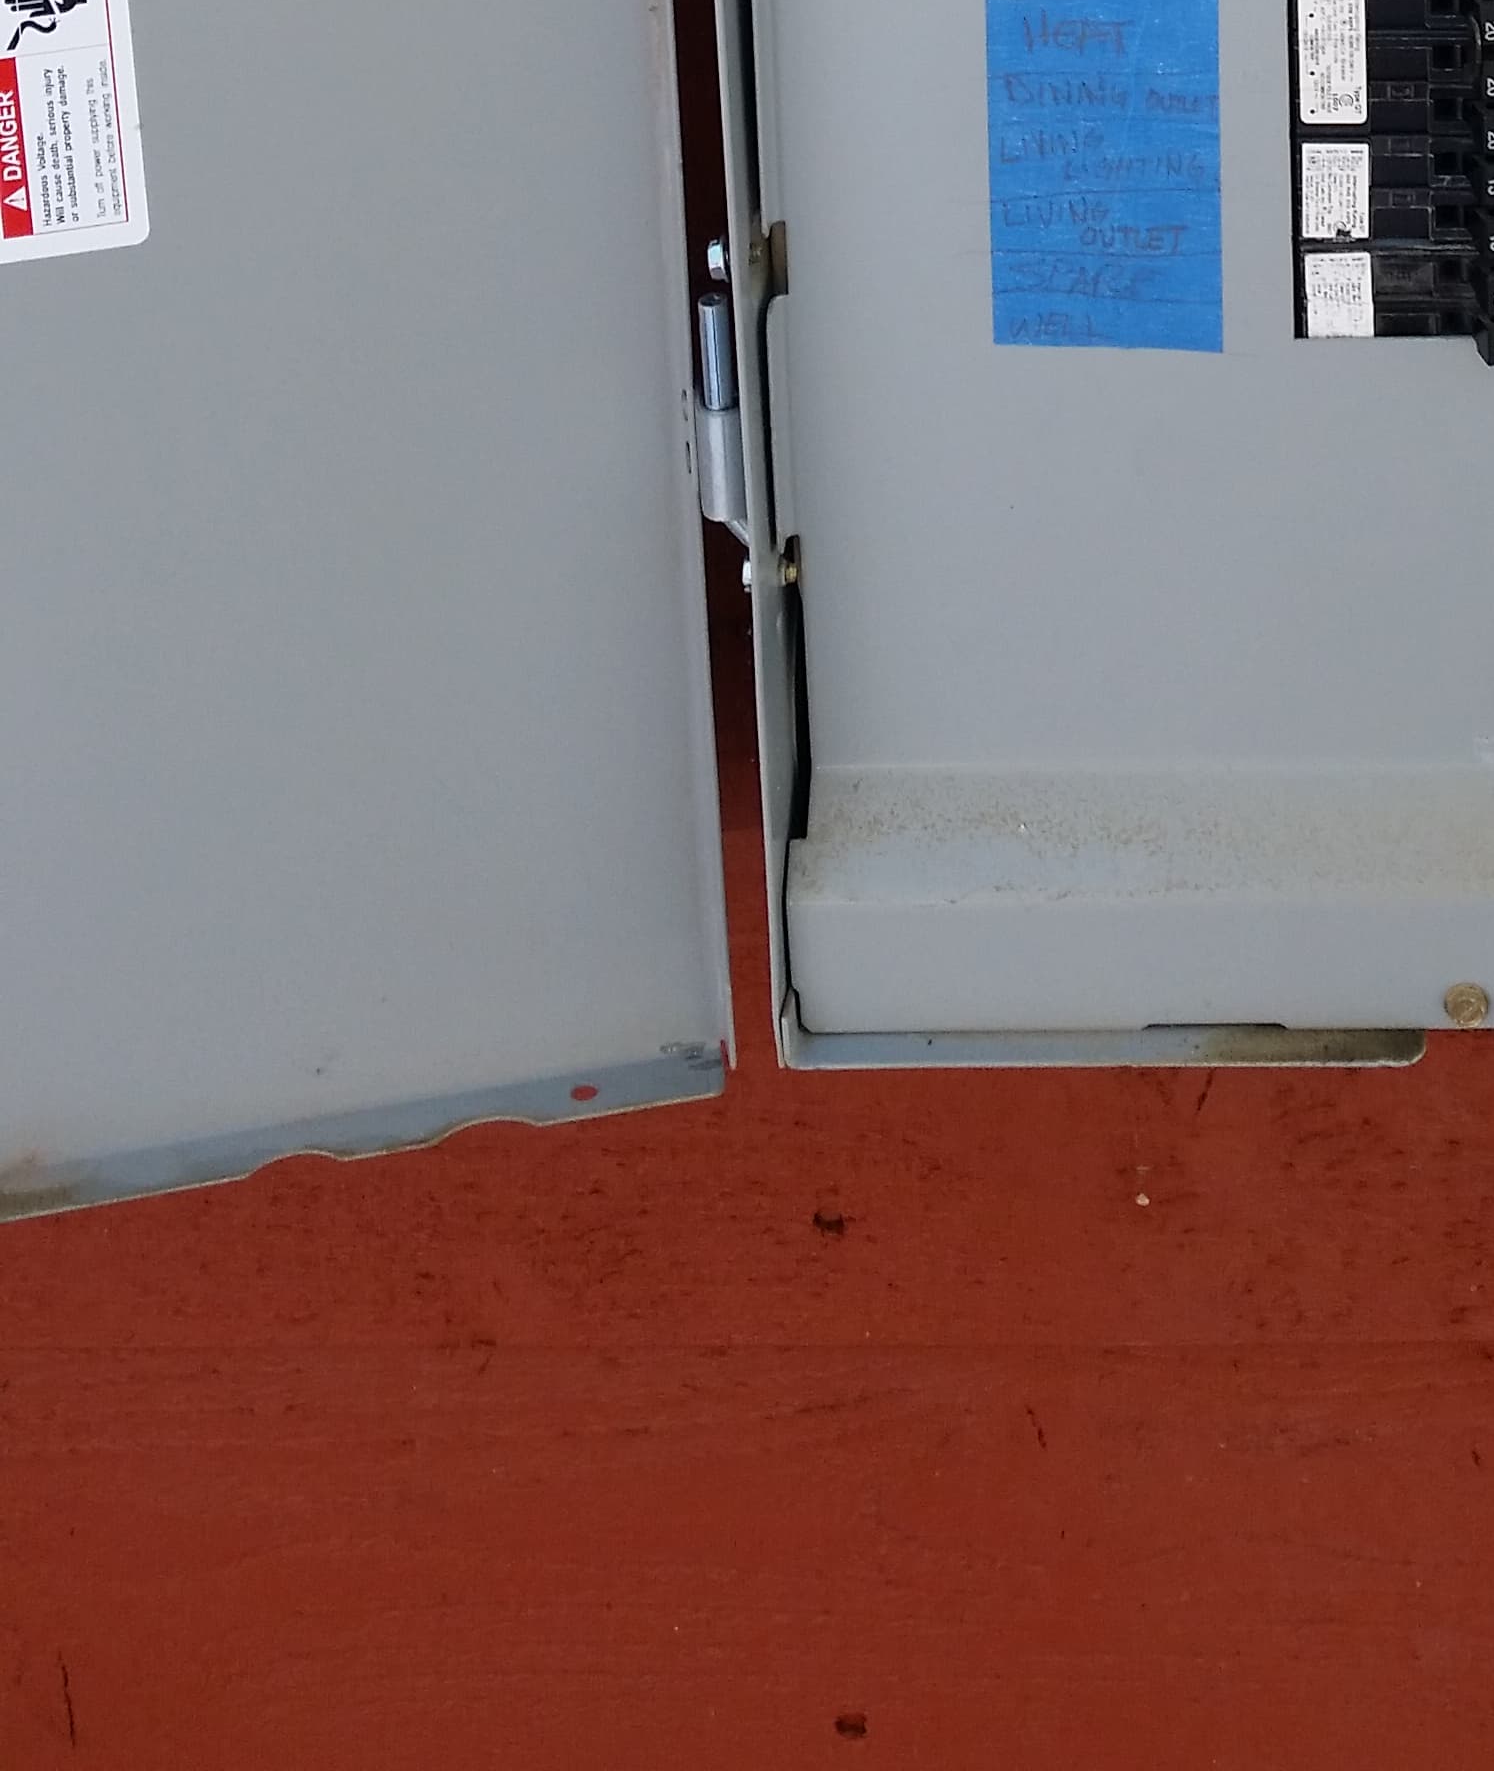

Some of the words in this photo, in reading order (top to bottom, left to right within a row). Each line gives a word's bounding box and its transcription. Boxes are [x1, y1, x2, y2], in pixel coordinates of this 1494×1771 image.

[41, 68, 55, 96] injury
[54, 64, 69, 106] damage.
[0, 89, 22, 181] DANGER
[44, 99, 57, 136] serious
[59, 109, 74, 151] property
[86, 98, 101, 144] supplying
[34, 132, 48, 171] Voltage.
[48, 140, 61, 170] death,
[92, 148, 103, 177] power
[38, 174, 52, 226] Hazardous
[52, 173, 63, 202] cause
[63, 155, 78, 208] substantial
[55, 206, 65, 224] Will
[70, 211, 79, 222] or
[1080, 225, 1187, 255] OUTLET
